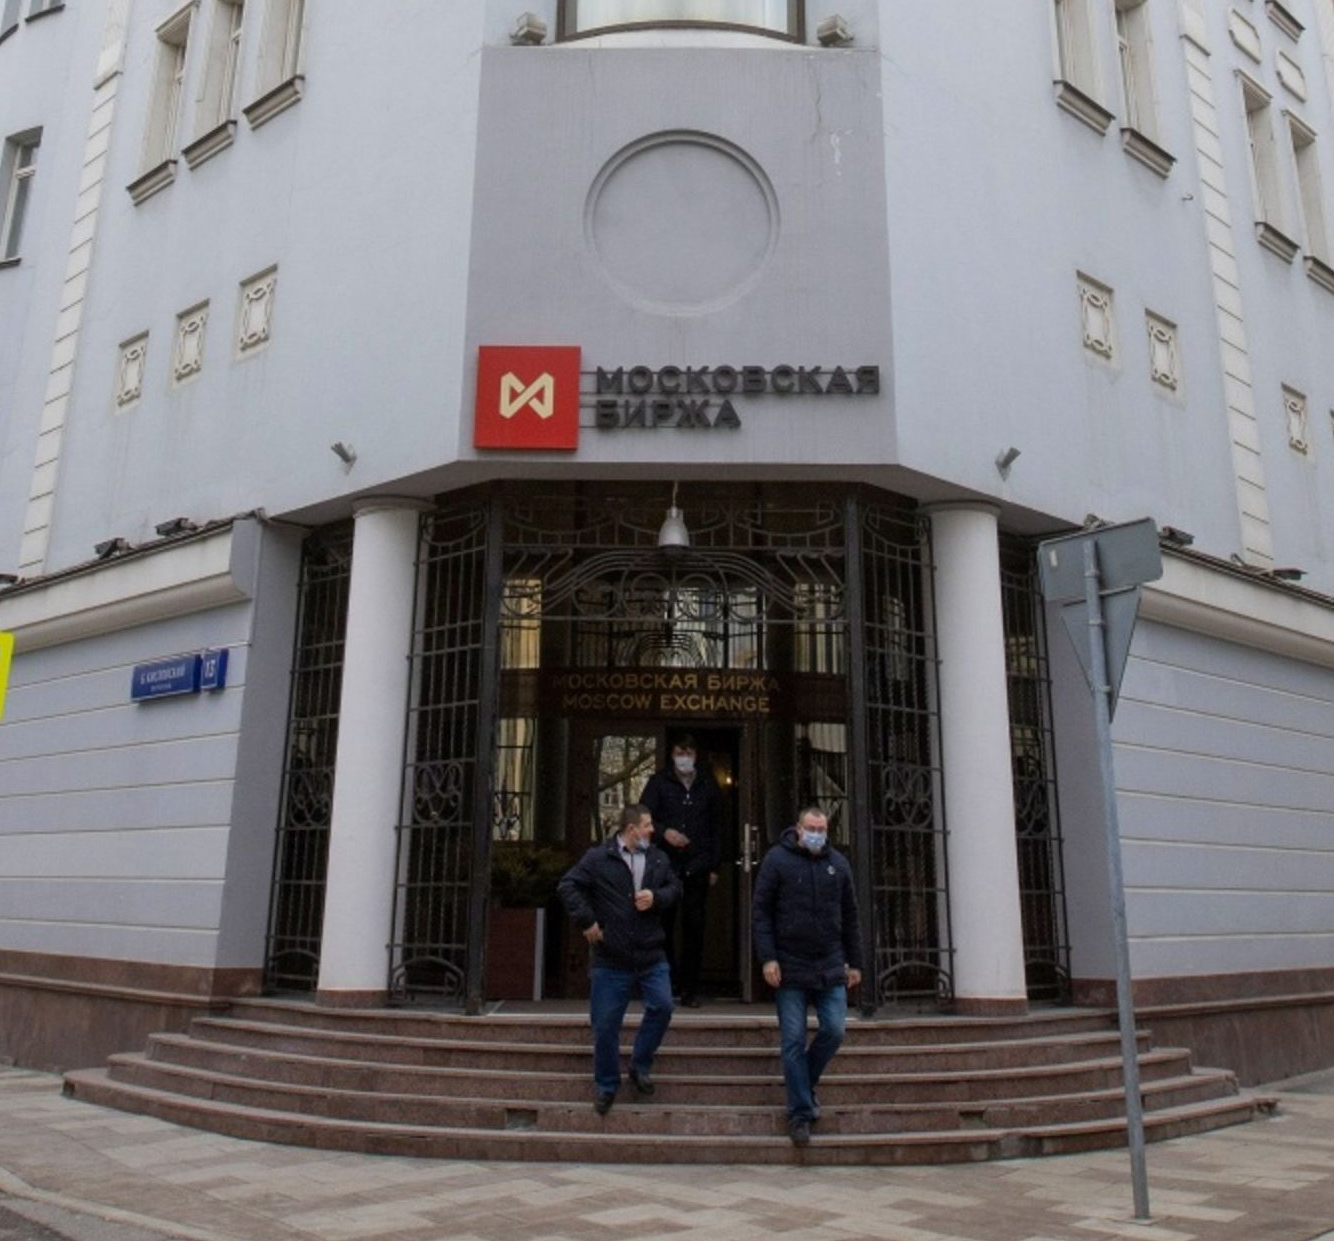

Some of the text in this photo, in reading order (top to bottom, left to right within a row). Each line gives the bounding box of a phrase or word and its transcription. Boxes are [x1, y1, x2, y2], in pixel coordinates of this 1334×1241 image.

[595, 365, 880, 395] МОСКОВСКАЯ
[595, 399, 743, 429] БИРЖА
[552, 673, 781, 692] МОСКОВСКАЯ БИРЖА
[562, 693, 771, 713] MOSCOW EXCHANGE
